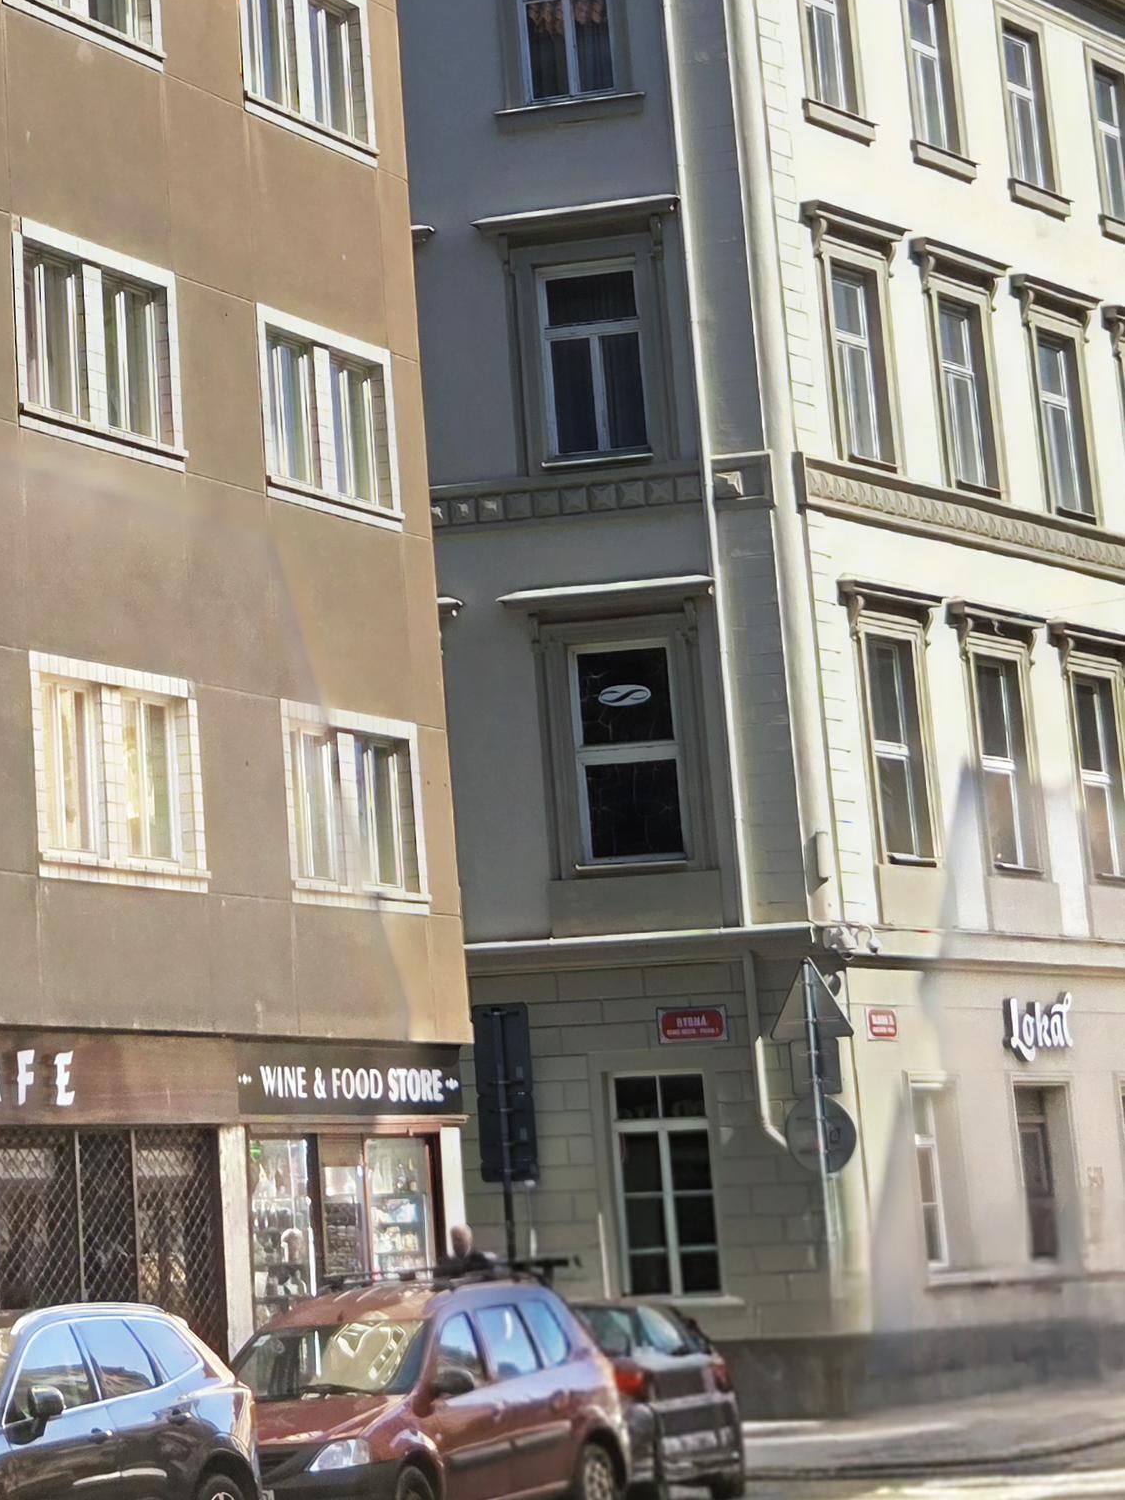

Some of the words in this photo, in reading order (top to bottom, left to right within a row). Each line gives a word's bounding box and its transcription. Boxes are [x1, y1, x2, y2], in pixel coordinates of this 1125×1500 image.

[259, 1065, 308, 1099] WINE
[313, 1066, 328, 1100] &
[331, 1067, 384, 1100] FOOD
[387, 1067, 445, 1102] STORE
